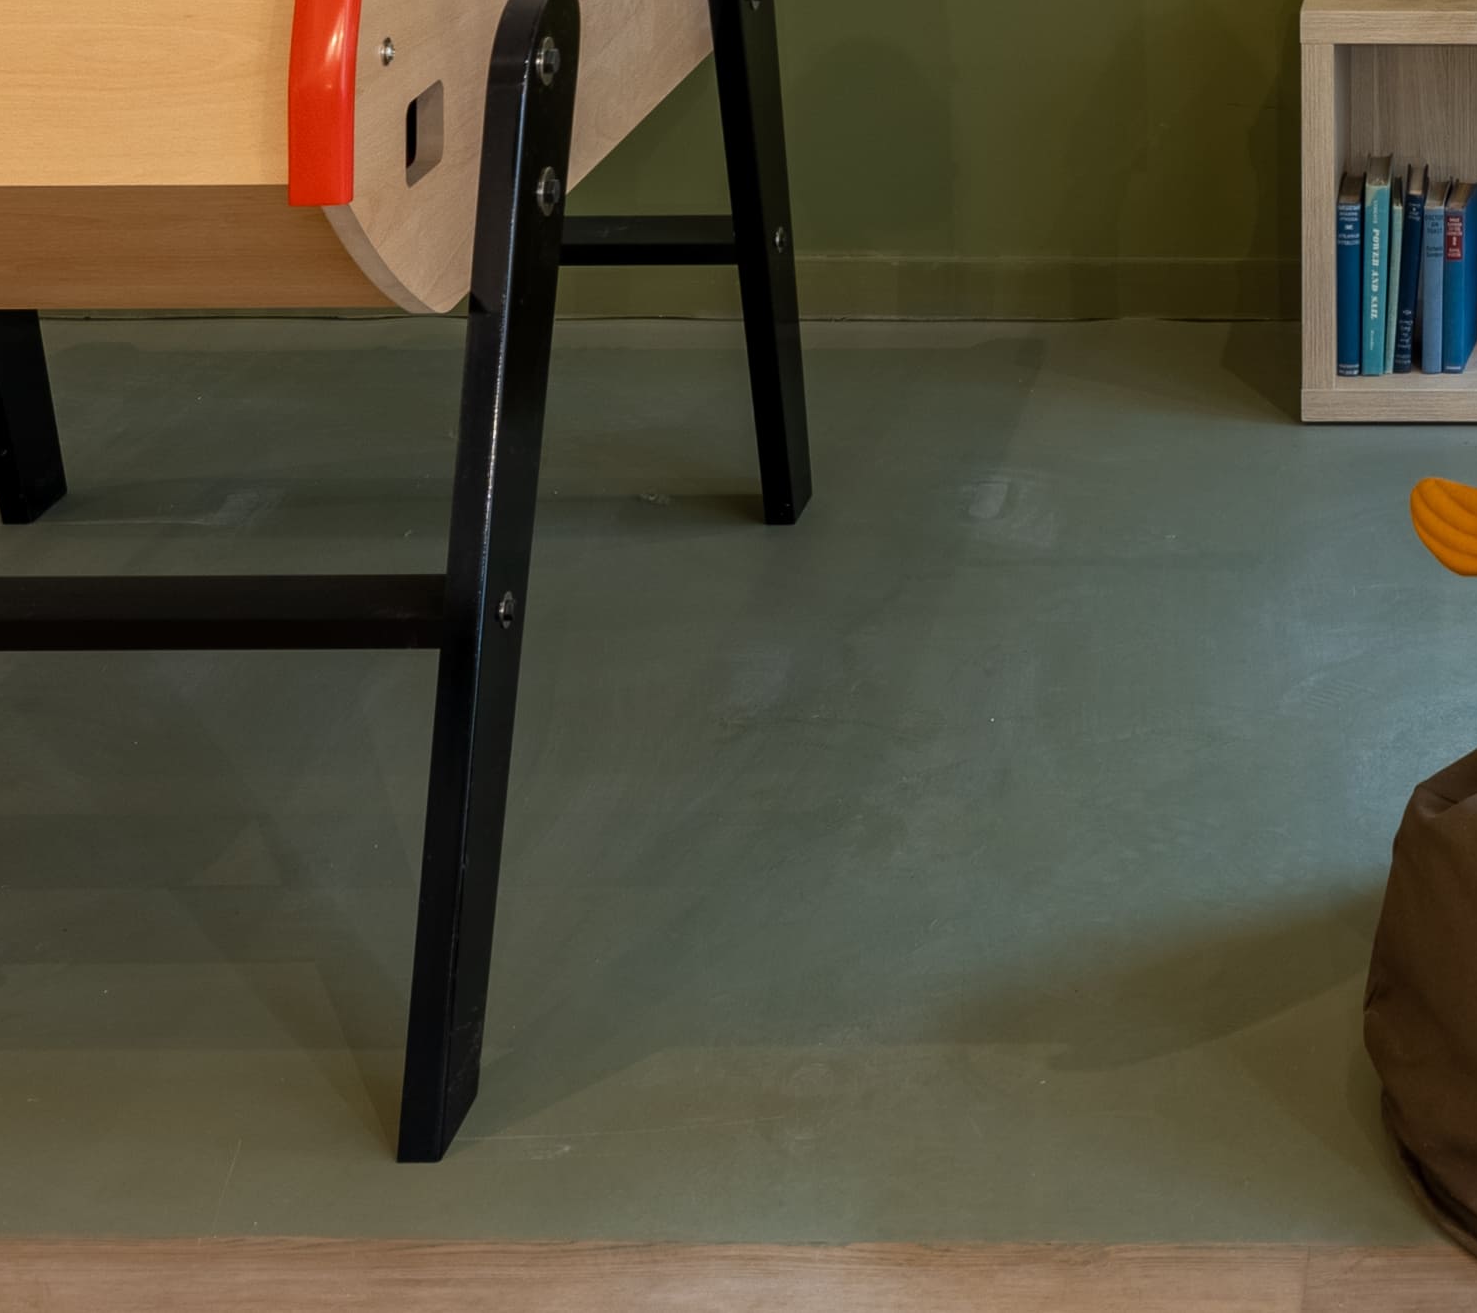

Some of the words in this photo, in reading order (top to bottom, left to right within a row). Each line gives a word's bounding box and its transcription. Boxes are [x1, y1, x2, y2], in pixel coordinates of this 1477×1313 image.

[1372, 228, 1380, 266] POWER
[1371, 270, 1379, 292] AND
[1370, 295, 1378, 320] SAIL
